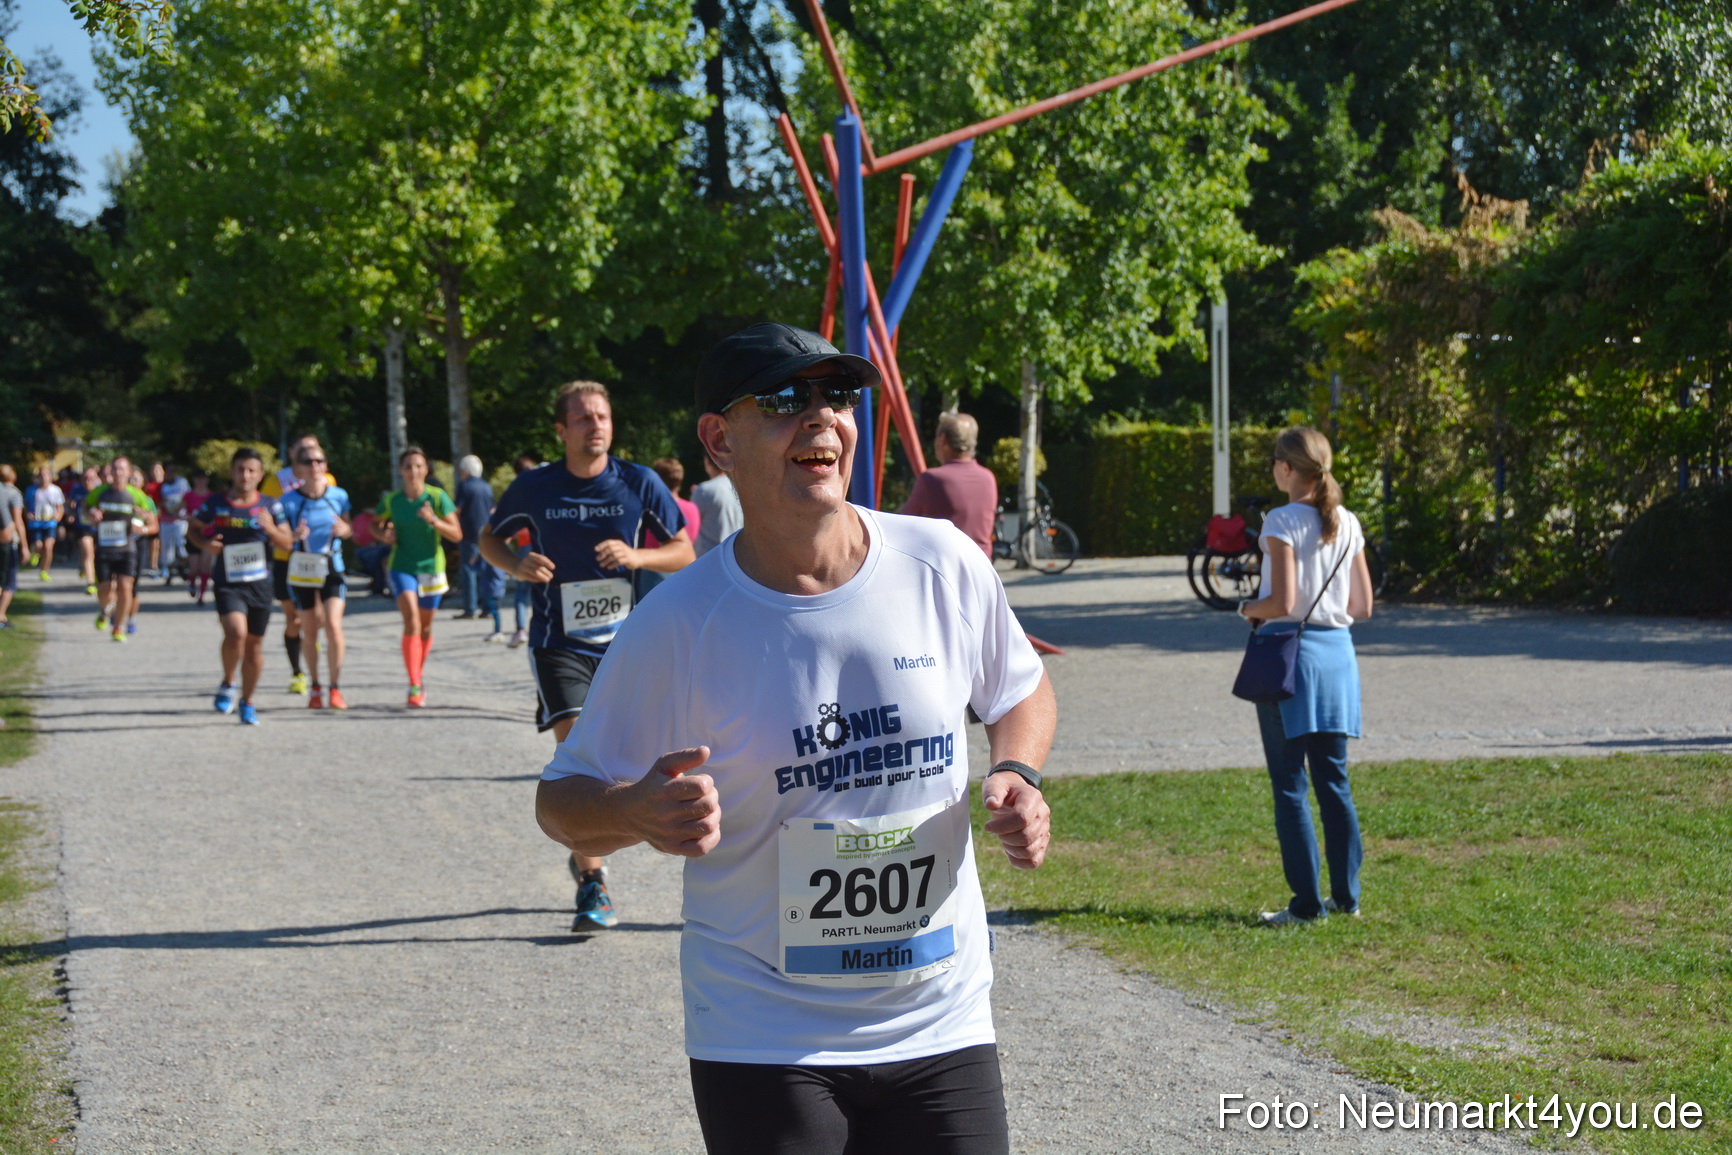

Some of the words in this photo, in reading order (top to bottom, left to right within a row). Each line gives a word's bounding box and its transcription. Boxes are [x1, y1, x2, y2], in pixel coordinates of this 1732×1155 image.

[573, 595, 622, 620] 2626
[892, 654, 937, 671] Martin
[792, 702, 902, 758] KÖNIG
[774, 731, 954, 795] Engineering
[834, 780, 850, 793] we
[854, 774, 883, 789] build
[887, 770, 916, 786] your
[919, 763, 944, 778] tools
[836, 826, 915, 853] BOCK
[836, 852, 862, 861] inspired
[863, 852, 871, 860] by
[871, 850, 890, 858] smart
[890, 844, 916, 855] concepts
[809, 854, 936, 920] 2607
[821, 926, 862, 938] PARTL
[864, 920, 917, 935] Neumarkt
[841, 945, 913, 970] Martin
